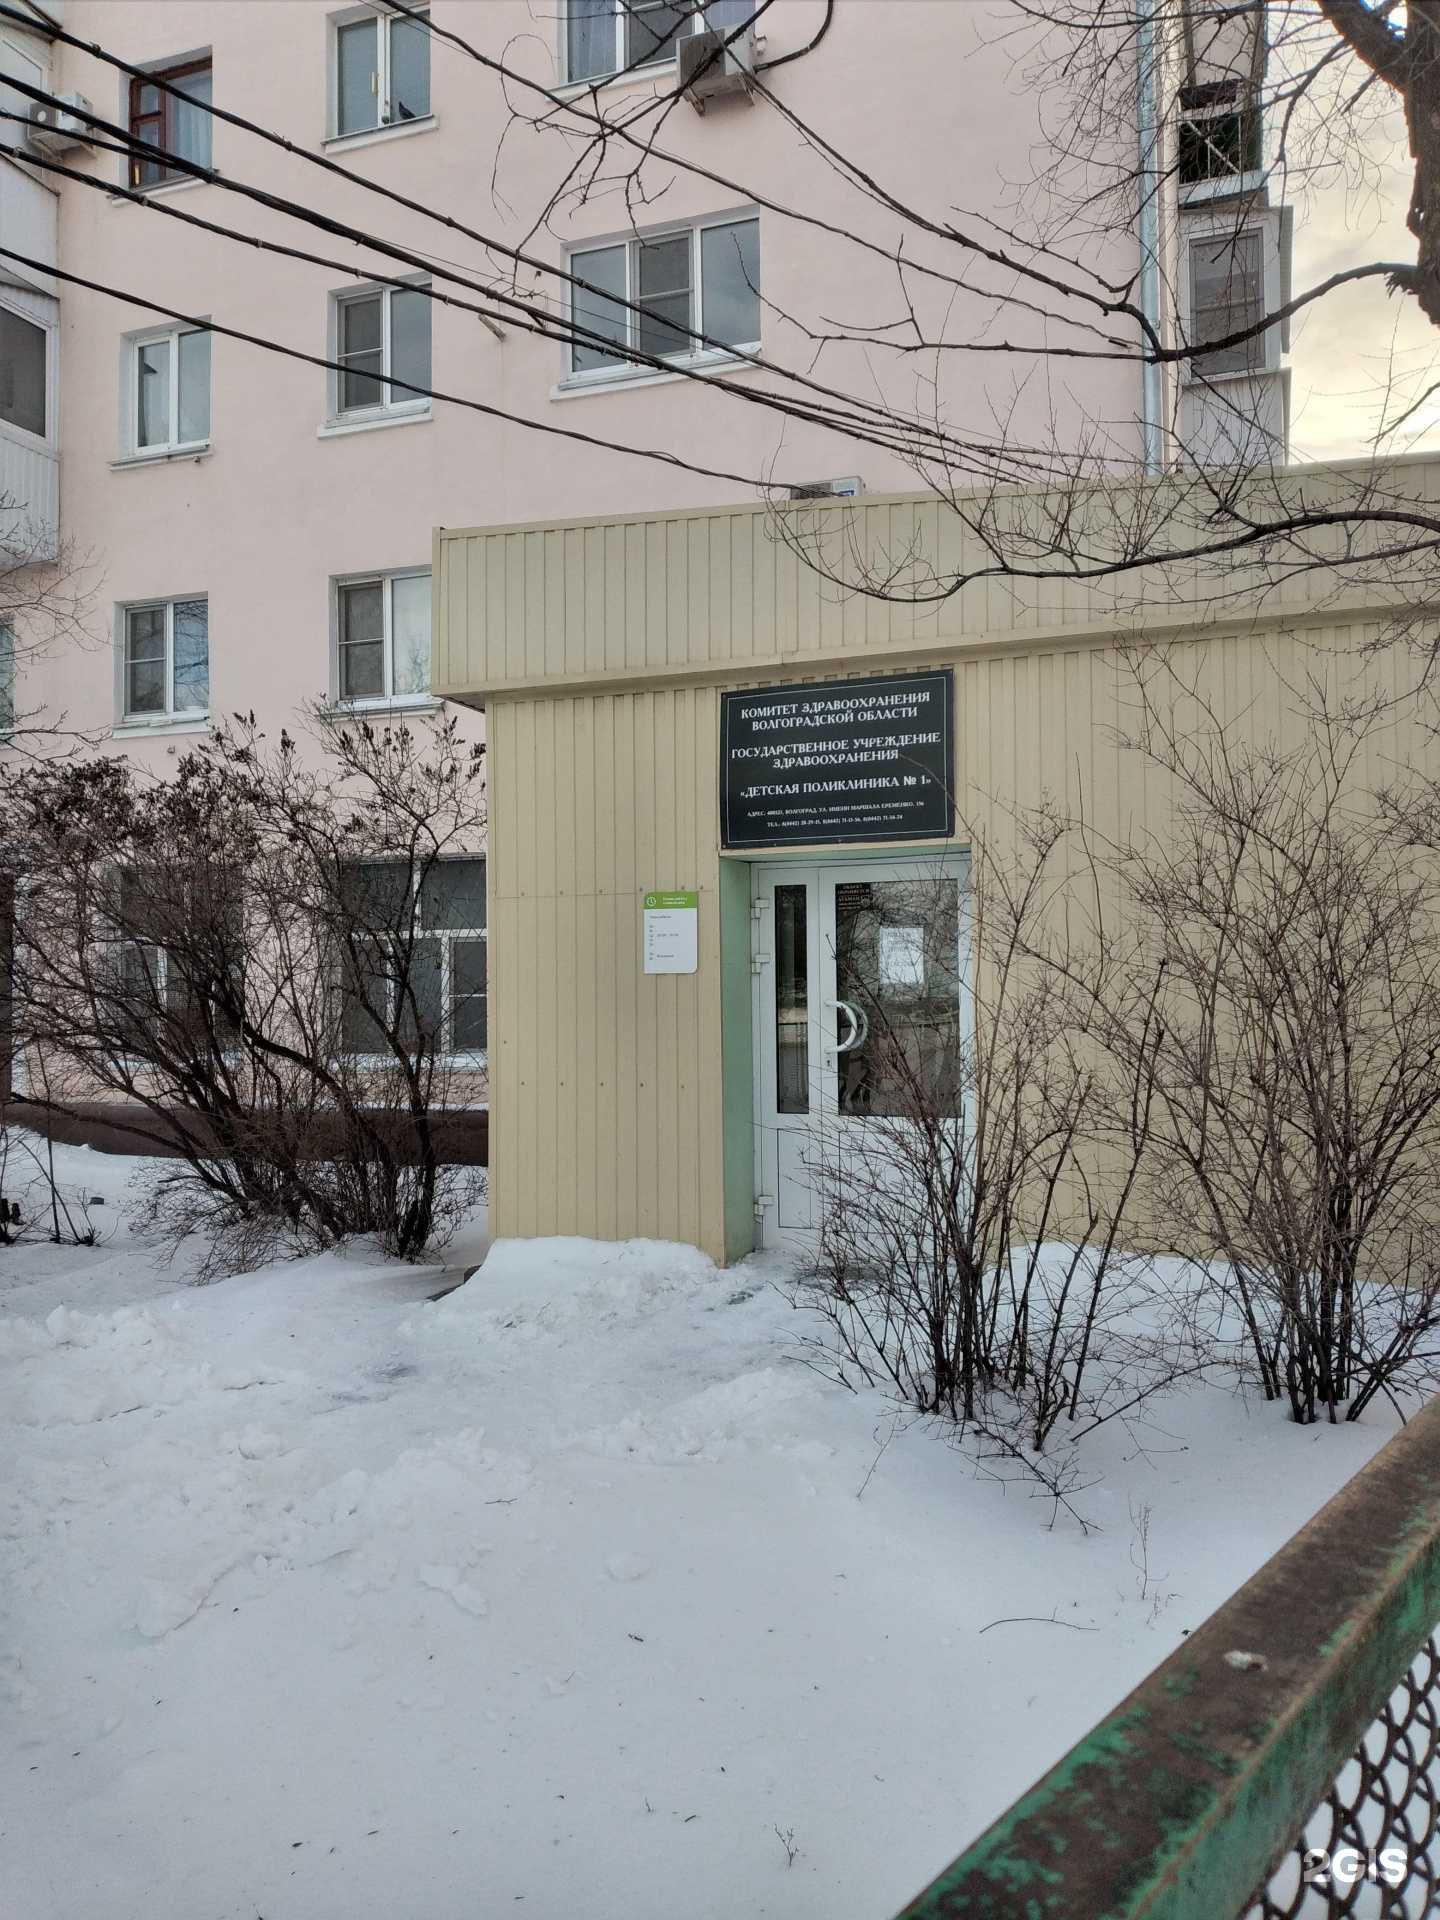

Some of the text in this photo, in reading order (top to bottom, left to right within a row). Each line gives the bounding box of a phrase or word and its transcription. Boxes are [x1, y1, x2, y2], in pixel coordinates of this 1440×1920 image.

[741, 692, 931, 719] КОМИТЕТ ЗДРАВООХРАНЕНИЯ
[752, 707, 918, 731] ВОЛГОГРАДСКОЙ ОБЛАСТИ
[731, 732, 941, 759] ГОСУДАРСТВЕННОЕ УЧРЕЖДЕНИЕ
[773, 749, 899, 769] ЗДРАВООХРАНЕНИЯ
[740, 782, 799, 798] «ДЕТСКАЯ
[803, 776, 900, 793] ПОЛИКЛИНИКА
